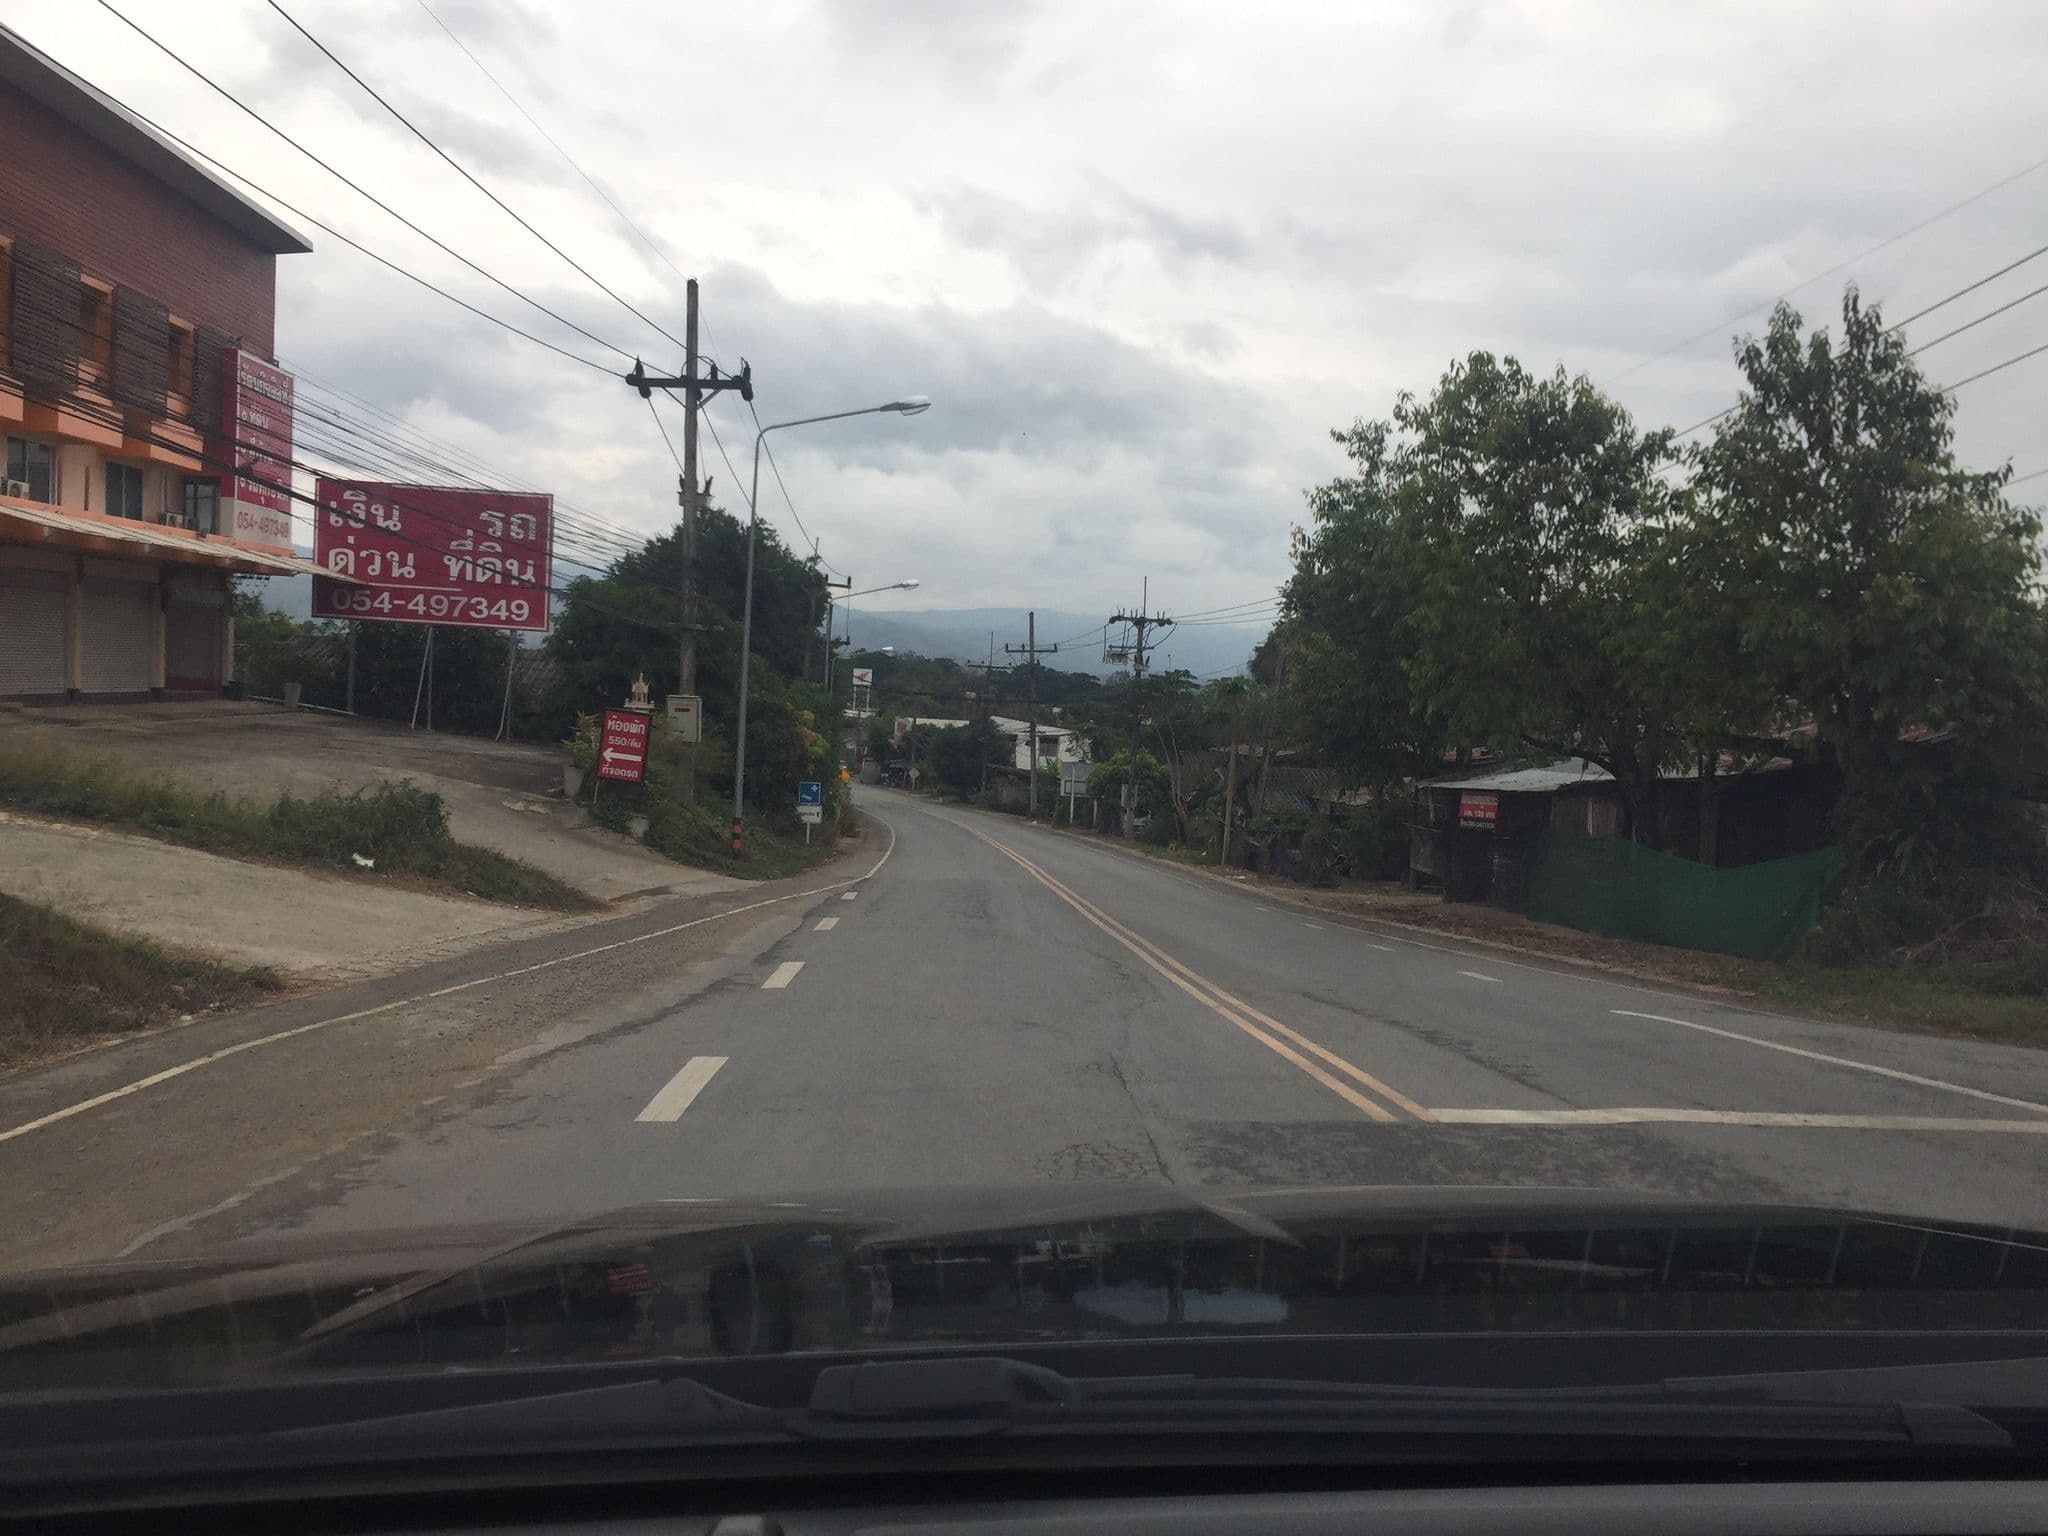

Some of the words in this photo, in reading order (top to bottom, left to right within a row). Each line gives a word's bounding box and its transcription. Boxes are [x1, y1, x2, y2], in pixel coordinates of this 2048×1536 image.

[329, 489, 402, 531] เงิน
[480, 509, 537, 540] รถ
[328, 535, 416, 579] ด่วน
[443, 529, 536, 585] ที่ดิน
[332, 589, 530, 622] 054-497349
[607, 715, 645, 735] ห้องพัก
[602, 762, 639, 778] ที่จอดรถ
